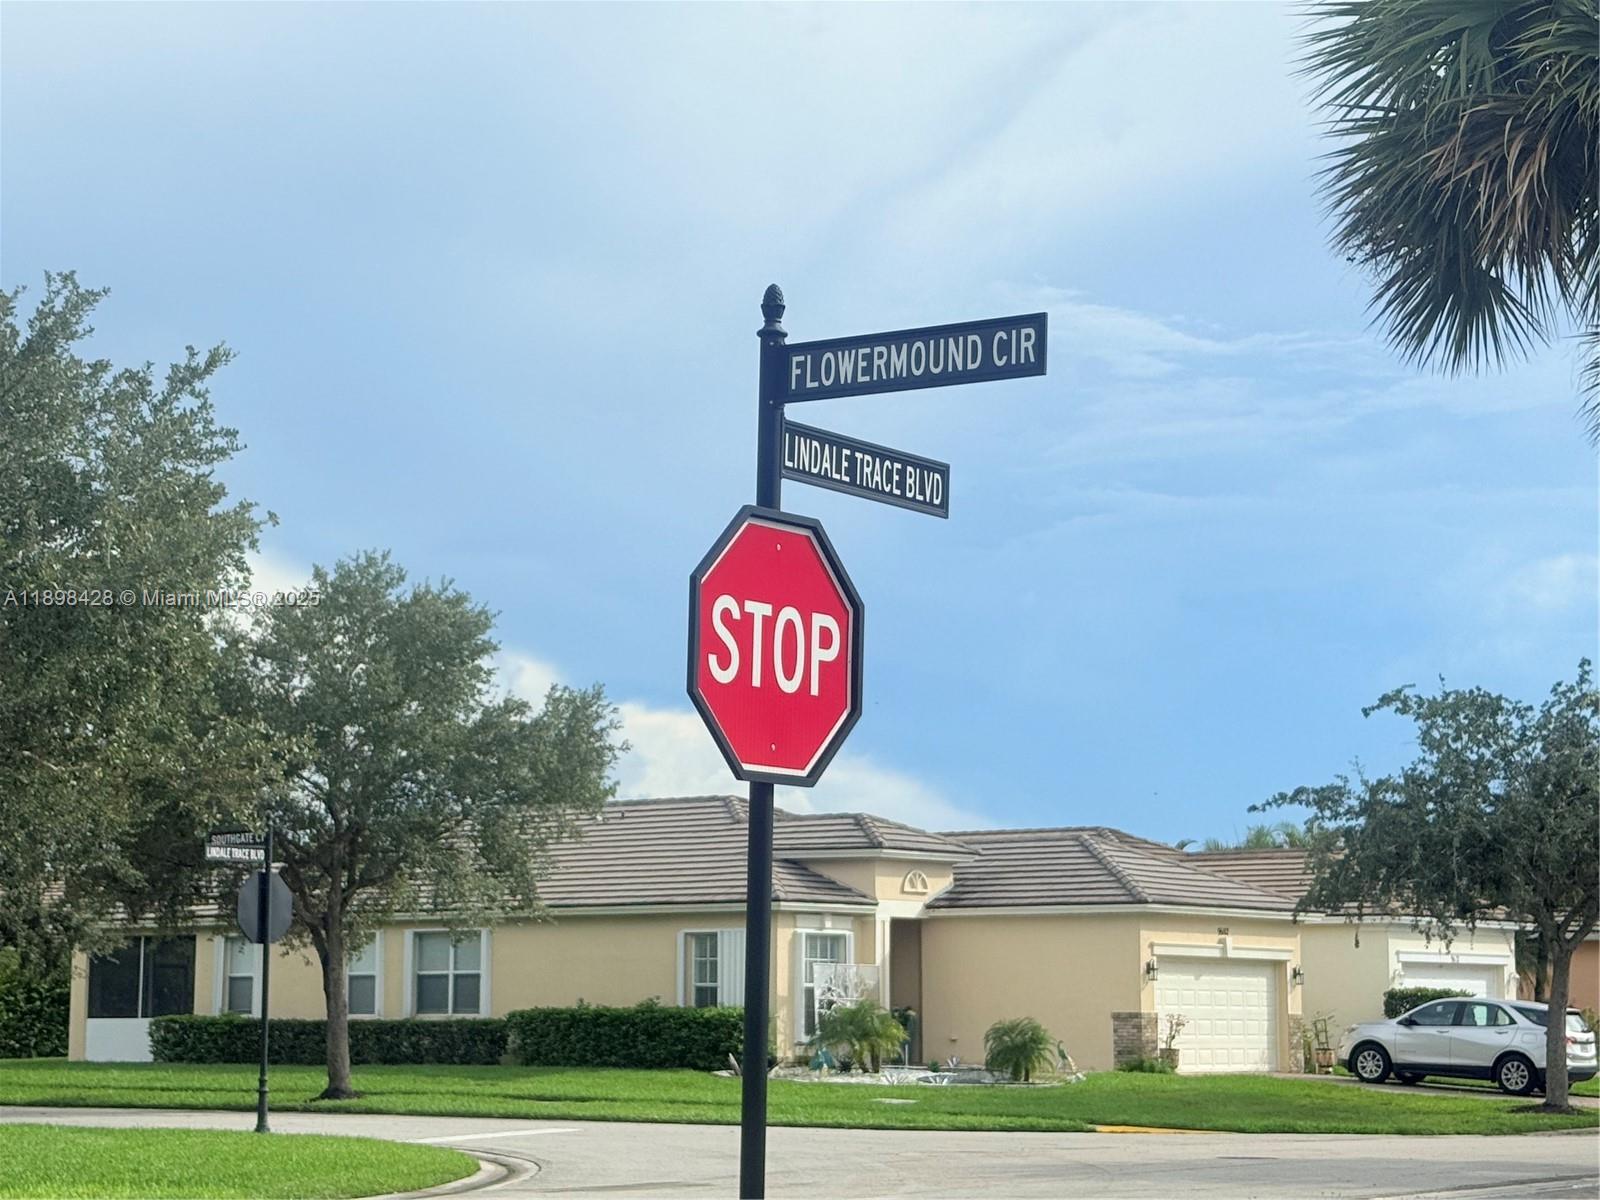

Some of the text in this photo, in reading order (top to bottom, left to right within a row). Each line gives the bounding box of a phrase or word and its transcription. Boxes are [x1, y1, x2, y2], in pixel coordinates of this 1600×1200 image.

[791, 327, 1036, 390] FLOWERMOUND CIR
[784, 433, 942, 505] LINDALE TRACE BLVD
[707, 594, 841, 696] STOP
[206, 846, 265, 861] LINDALE TRACE BLVD
[211, 832, 254, 846] SOUTHGATE
